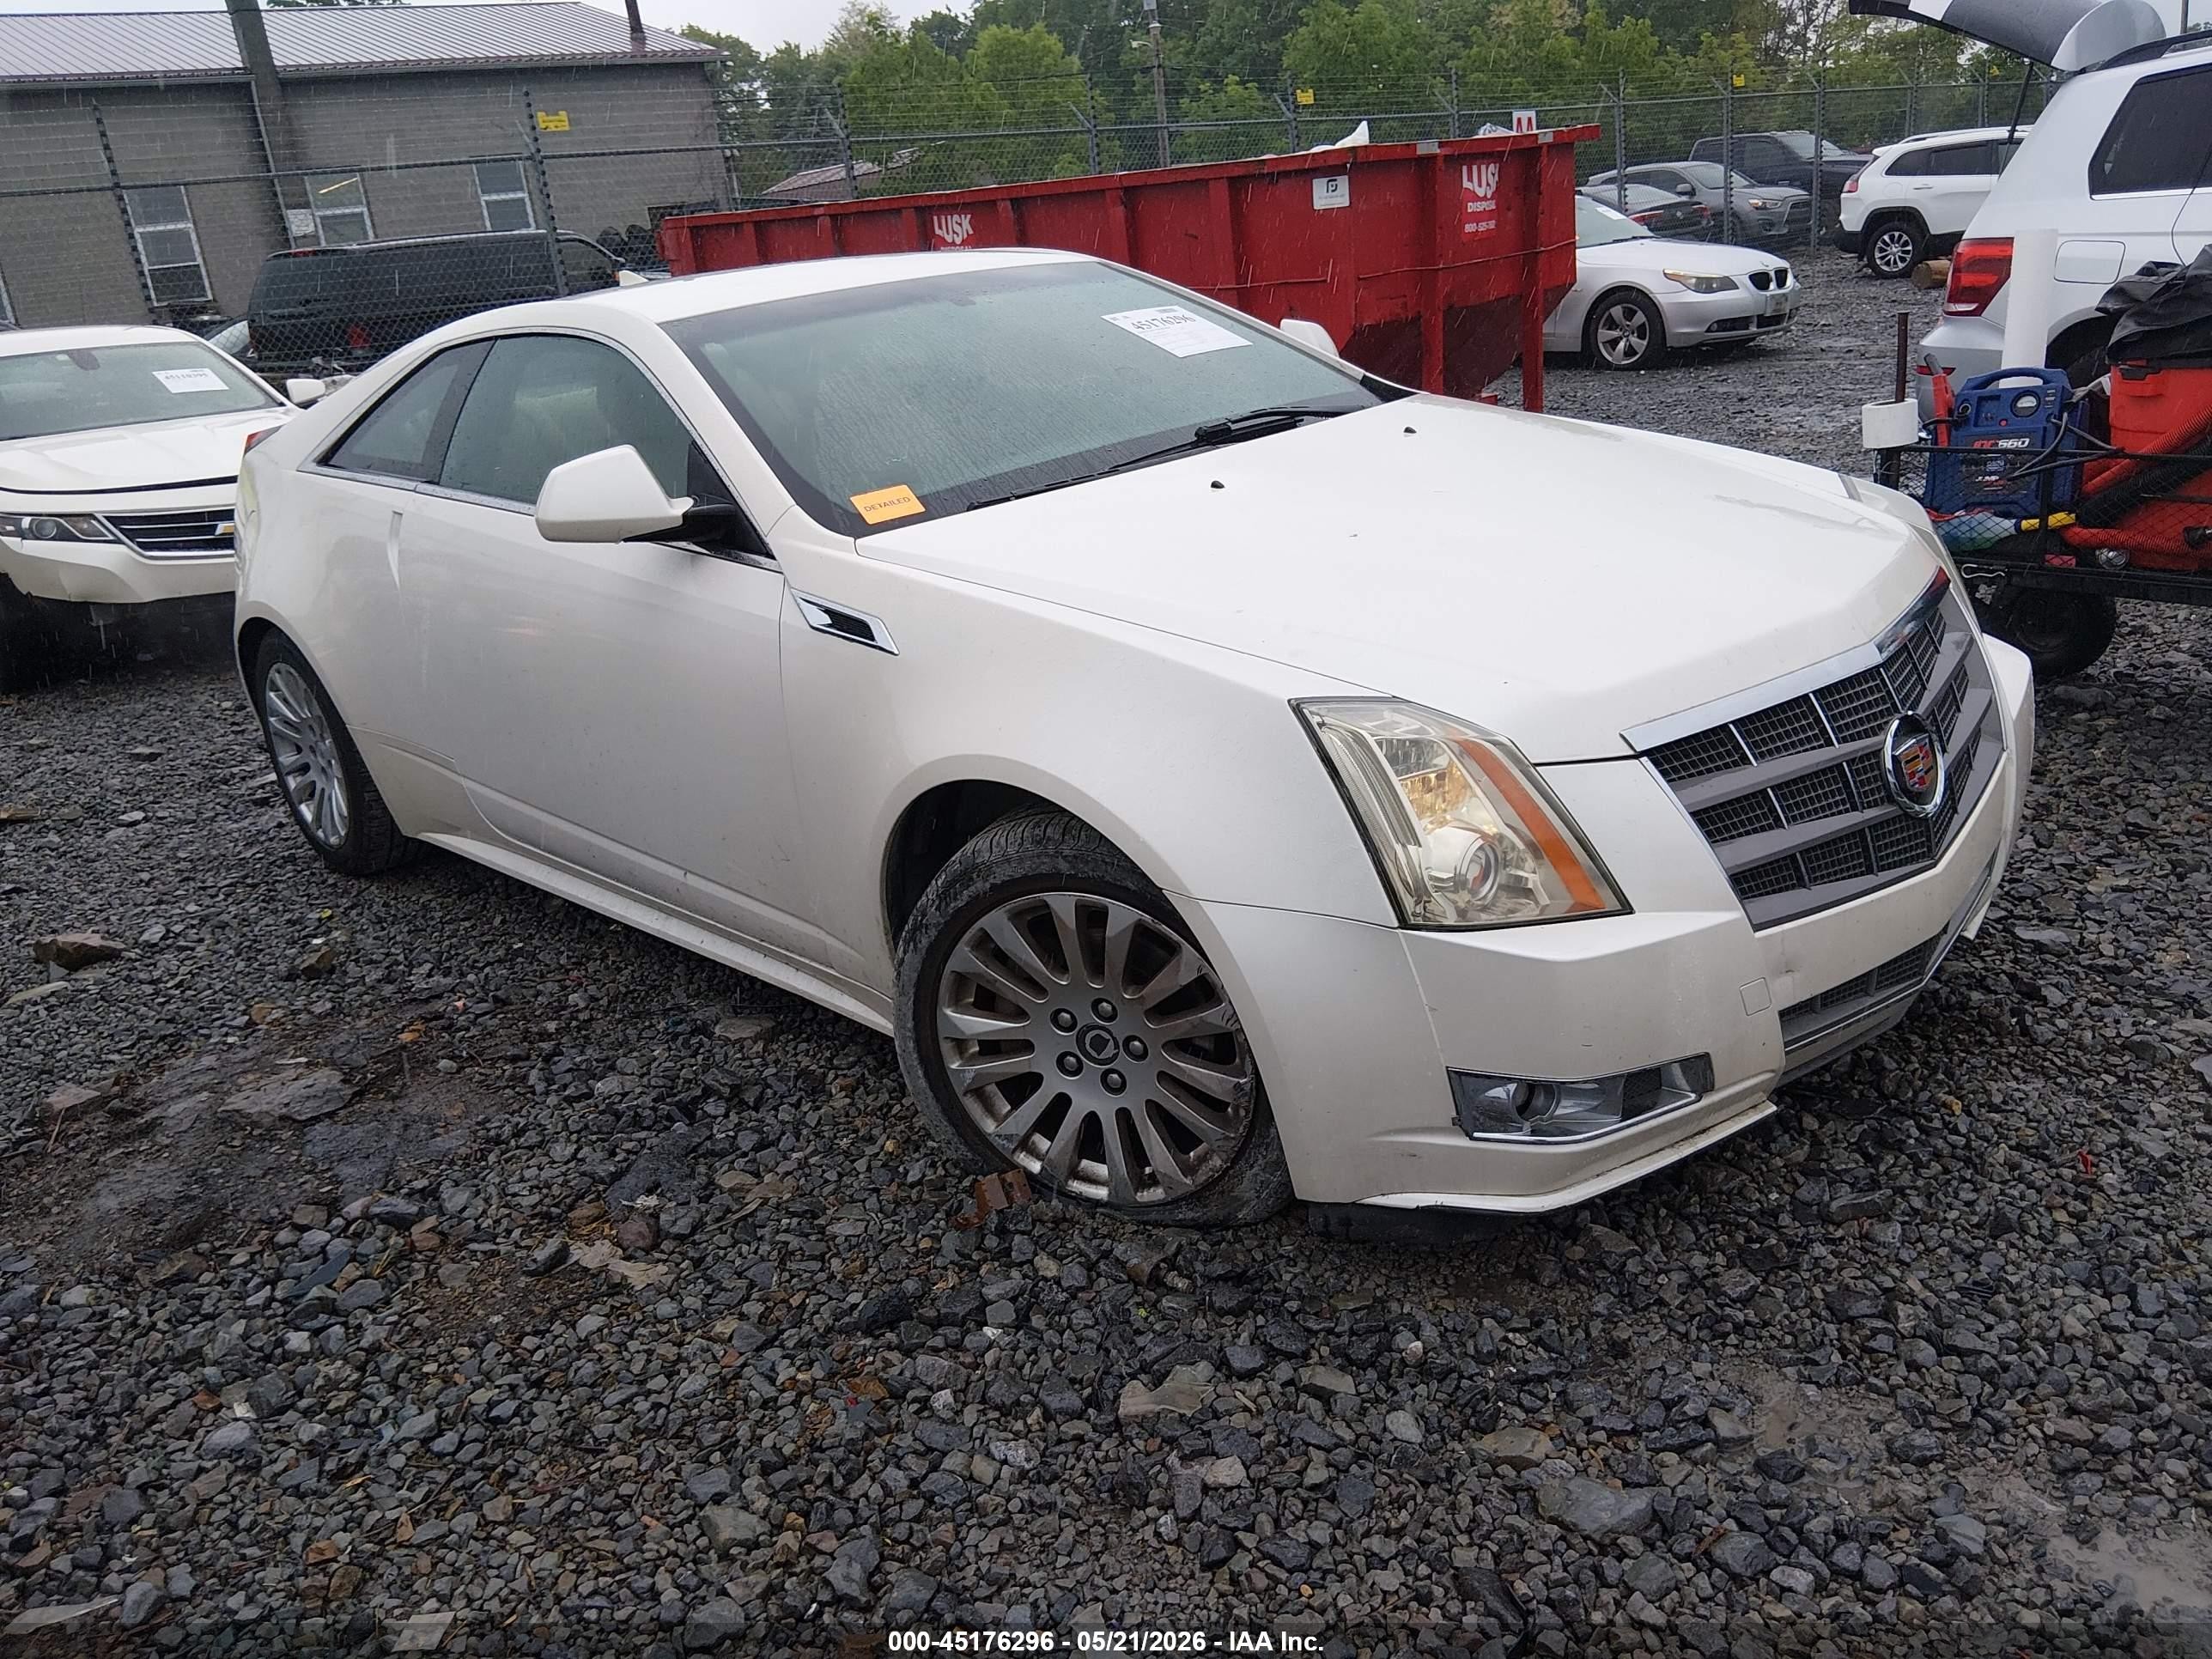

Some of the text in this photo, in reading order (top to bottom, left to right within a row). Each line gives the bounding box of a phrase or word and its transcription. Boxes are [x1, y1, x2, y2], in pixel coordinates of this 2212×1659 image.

[933, 214, 975, 246] LUSK
[1131, 314, 1196, 331] 45176296
[863, 496, 911, 513] DETAILED
